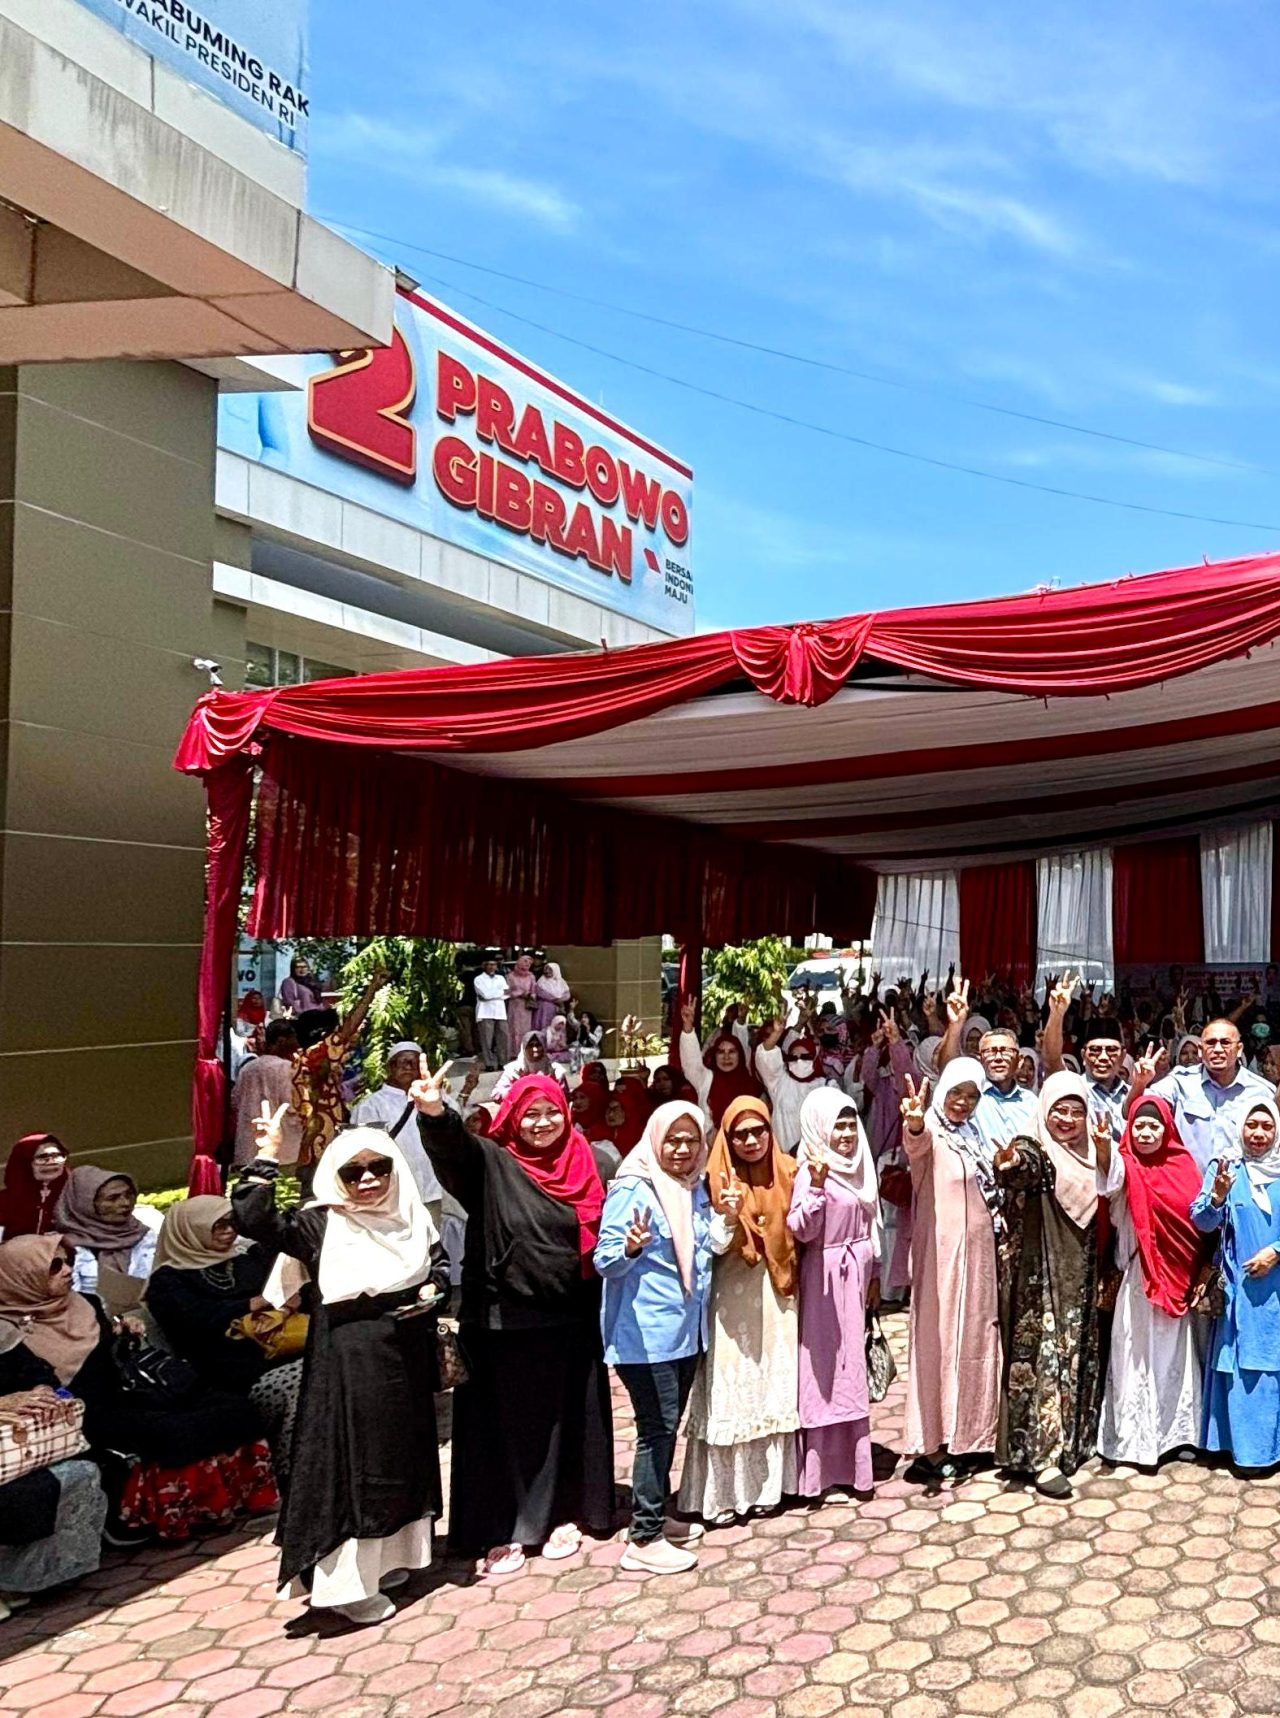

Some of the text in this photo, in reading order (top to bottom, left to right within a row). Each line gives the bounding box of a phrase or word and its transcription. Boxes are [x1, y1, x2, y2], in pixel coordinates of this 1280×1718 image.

[186, 34, 274, 111] PRESIDEN
[278, 103, 294, 126] RI
[436, 349, 689, 548] PRABOWO
[433, 435, 633, 585] GIBRAN
[665, 584, 688, 604] MAJU
